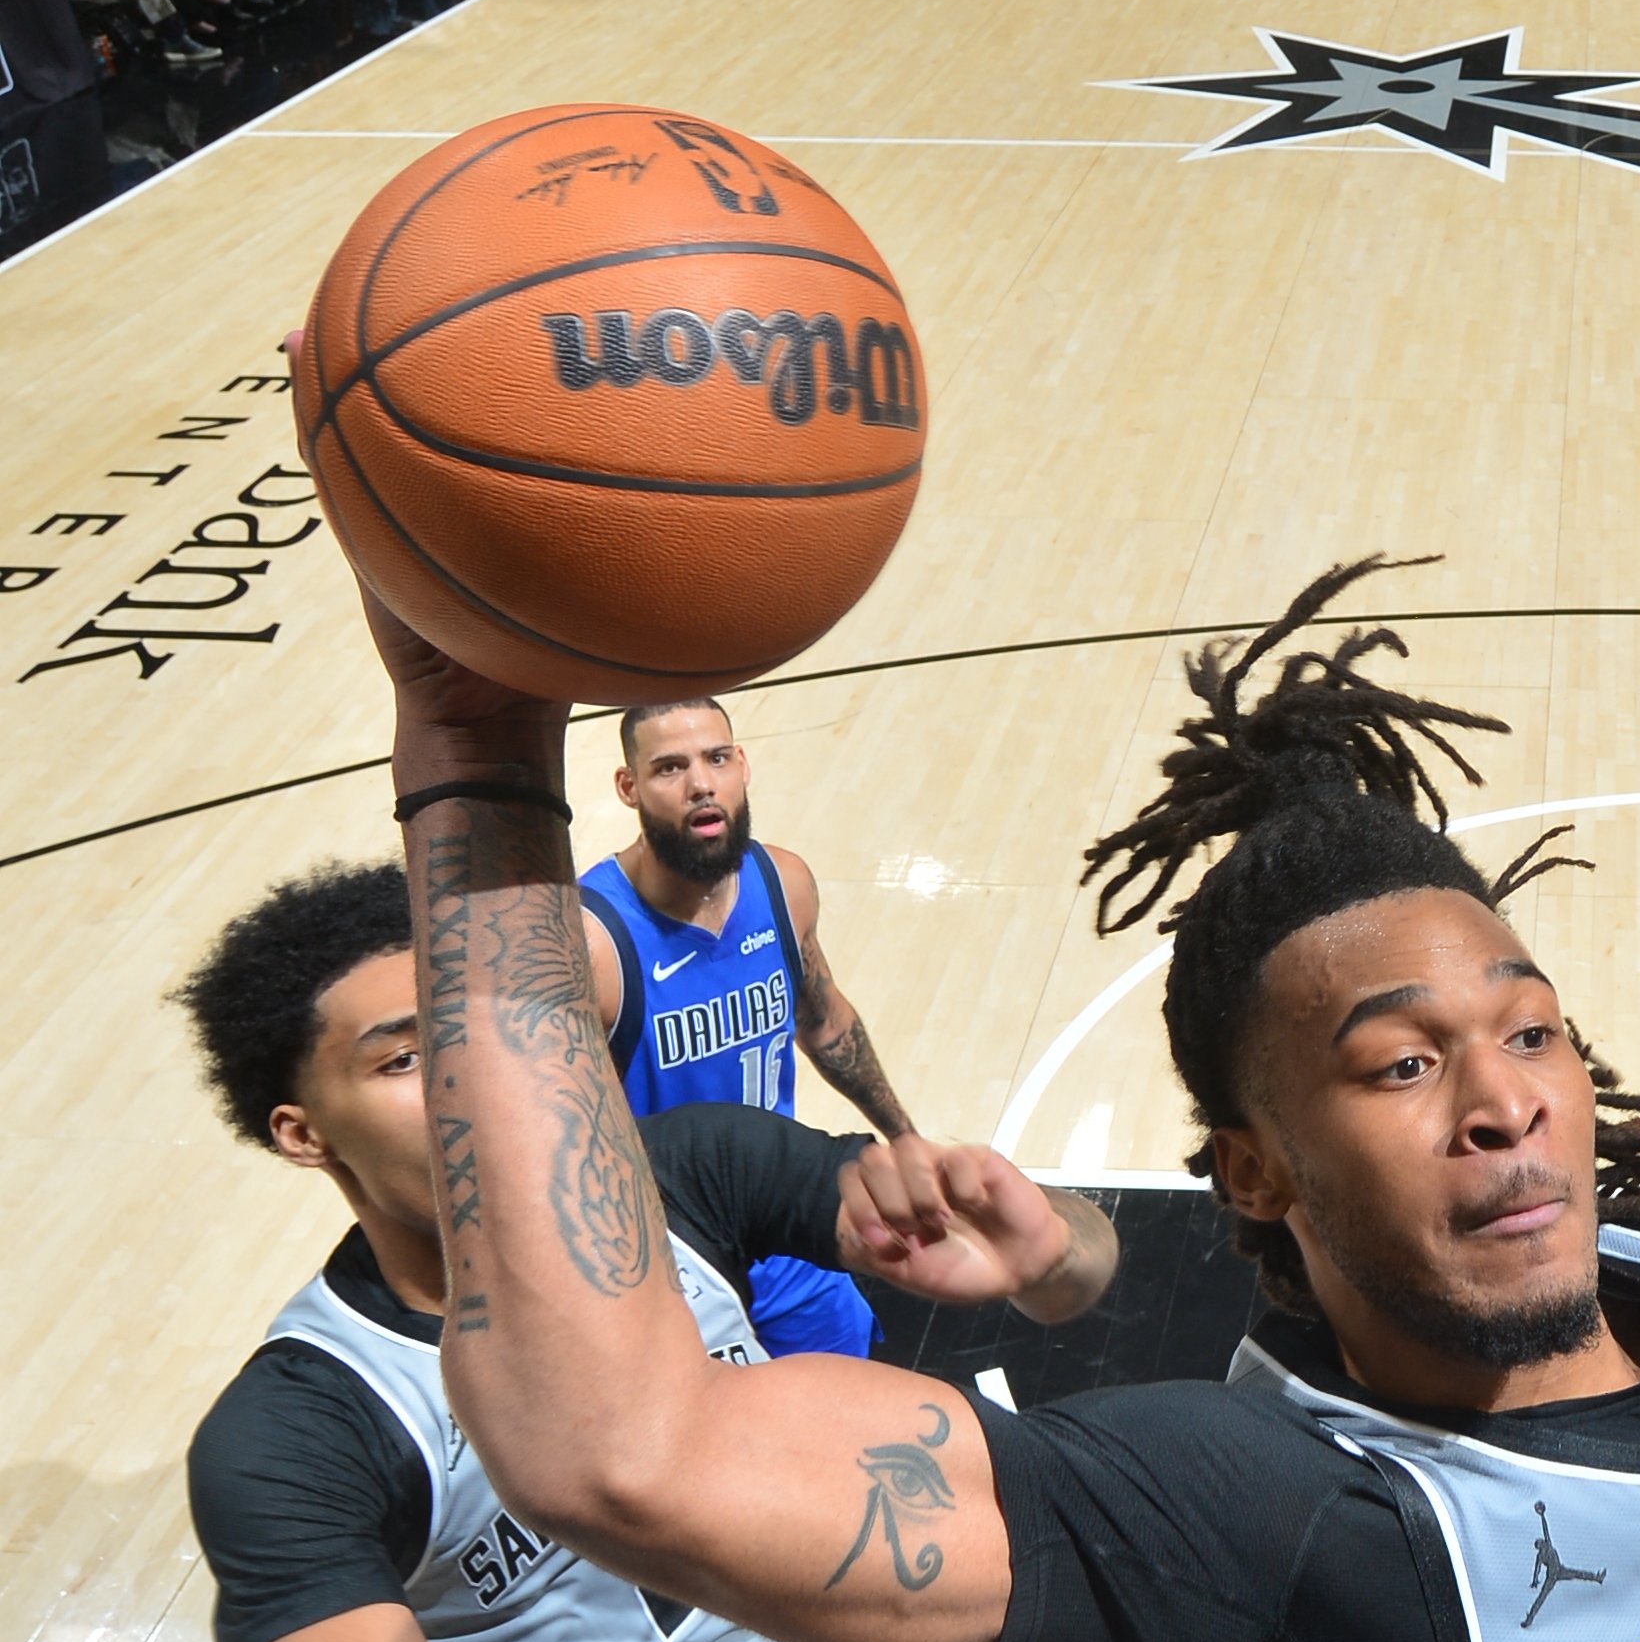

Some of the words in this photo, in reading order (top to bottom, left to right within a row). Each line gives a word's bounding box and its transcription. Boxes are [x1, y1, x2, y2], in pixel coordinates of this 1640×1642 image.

[541, 307, 921, 432] Wilson
[0, 342, 292, 593] ENTER
[739, 927, 778, 957] chime
[653, 969, 790, 1071] DALLAS
[738, 1030, 789, 1113] 16
[458, 1507, 556, 1611] SA
